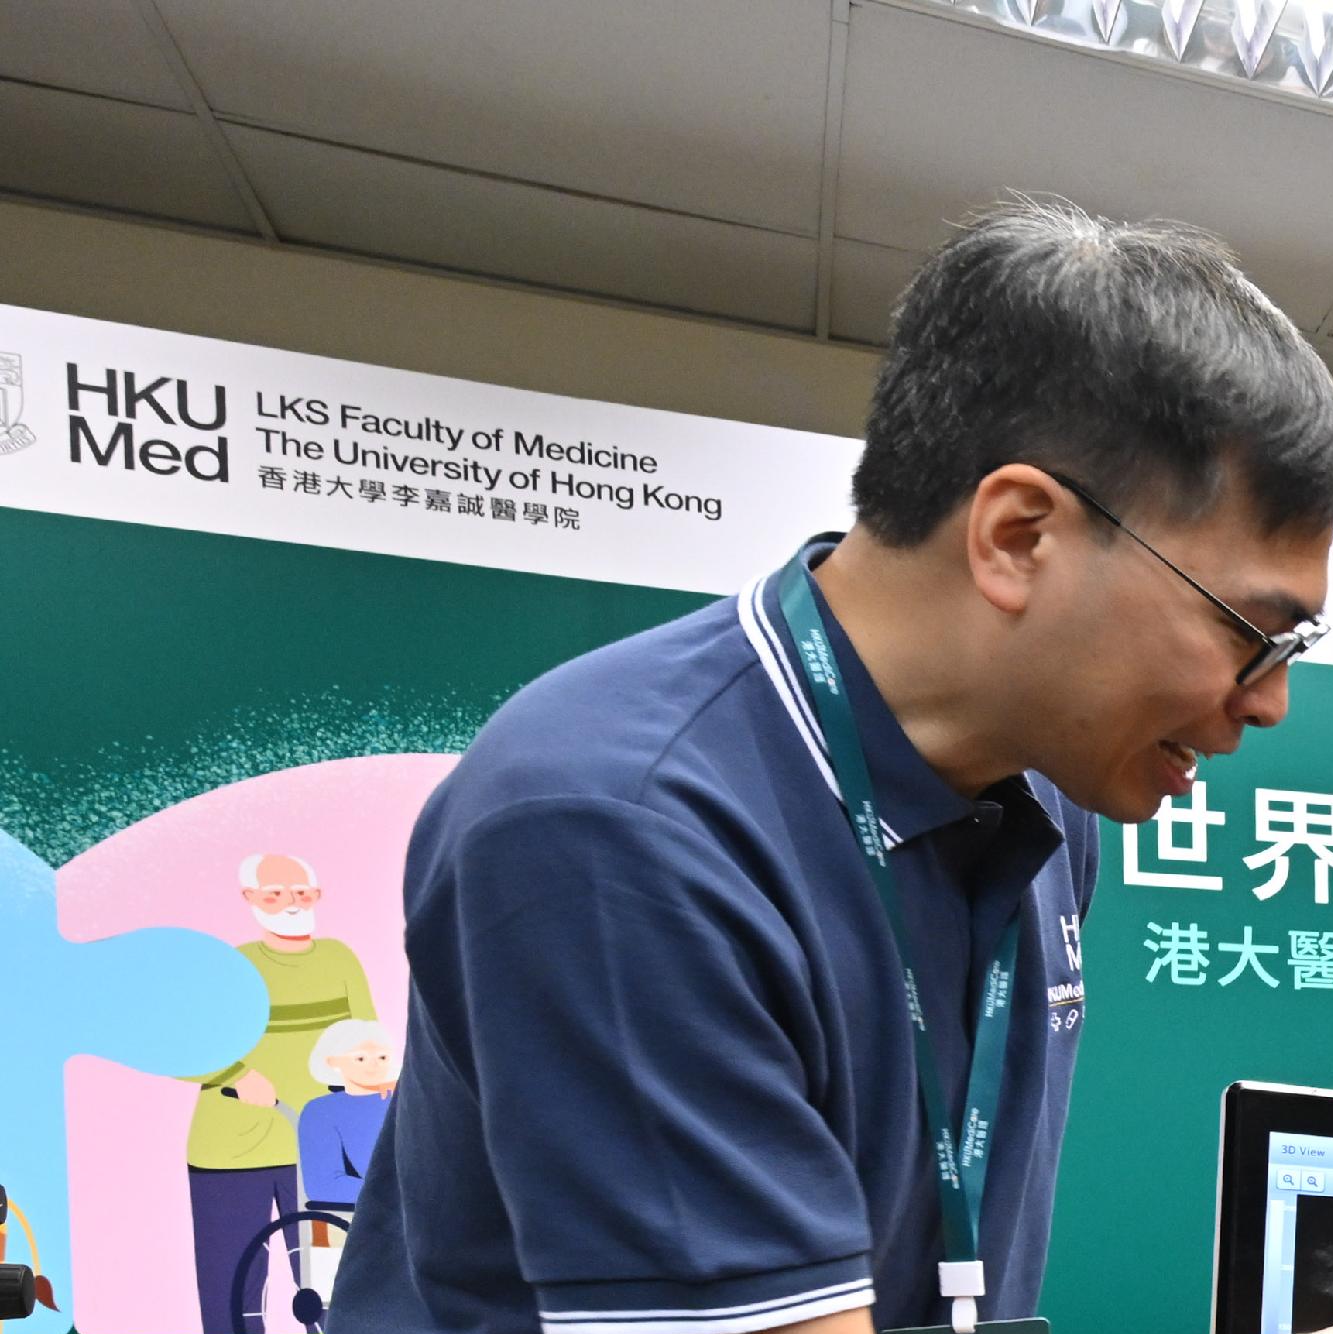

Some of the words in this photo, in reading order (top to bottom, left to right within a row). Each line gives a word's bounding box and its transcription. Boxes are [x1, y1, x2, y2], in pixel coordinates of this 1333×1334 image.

[66, 362, 226, 431] HKU
[69, 414, 229, 483] Med
[255, 391, 330, 425] LKS
[340, 403, 465, 451] Faculty
[471, 427, 504, 452] of
[513, 431, 658, 474] Medicine
[255, 427, 325, 461] The
[333, 438, 502, 491] University
[508, 468, 541, 492] of
[550, 471, 635, 511] Hong
[643, 483, 723, 521] Kong
[257, 465, 582, 531] 香港大學李嘉誠醫學院
[1281, 1144, 1296, 1155] 3D
[1300, 1146, 1326, 1157] View
